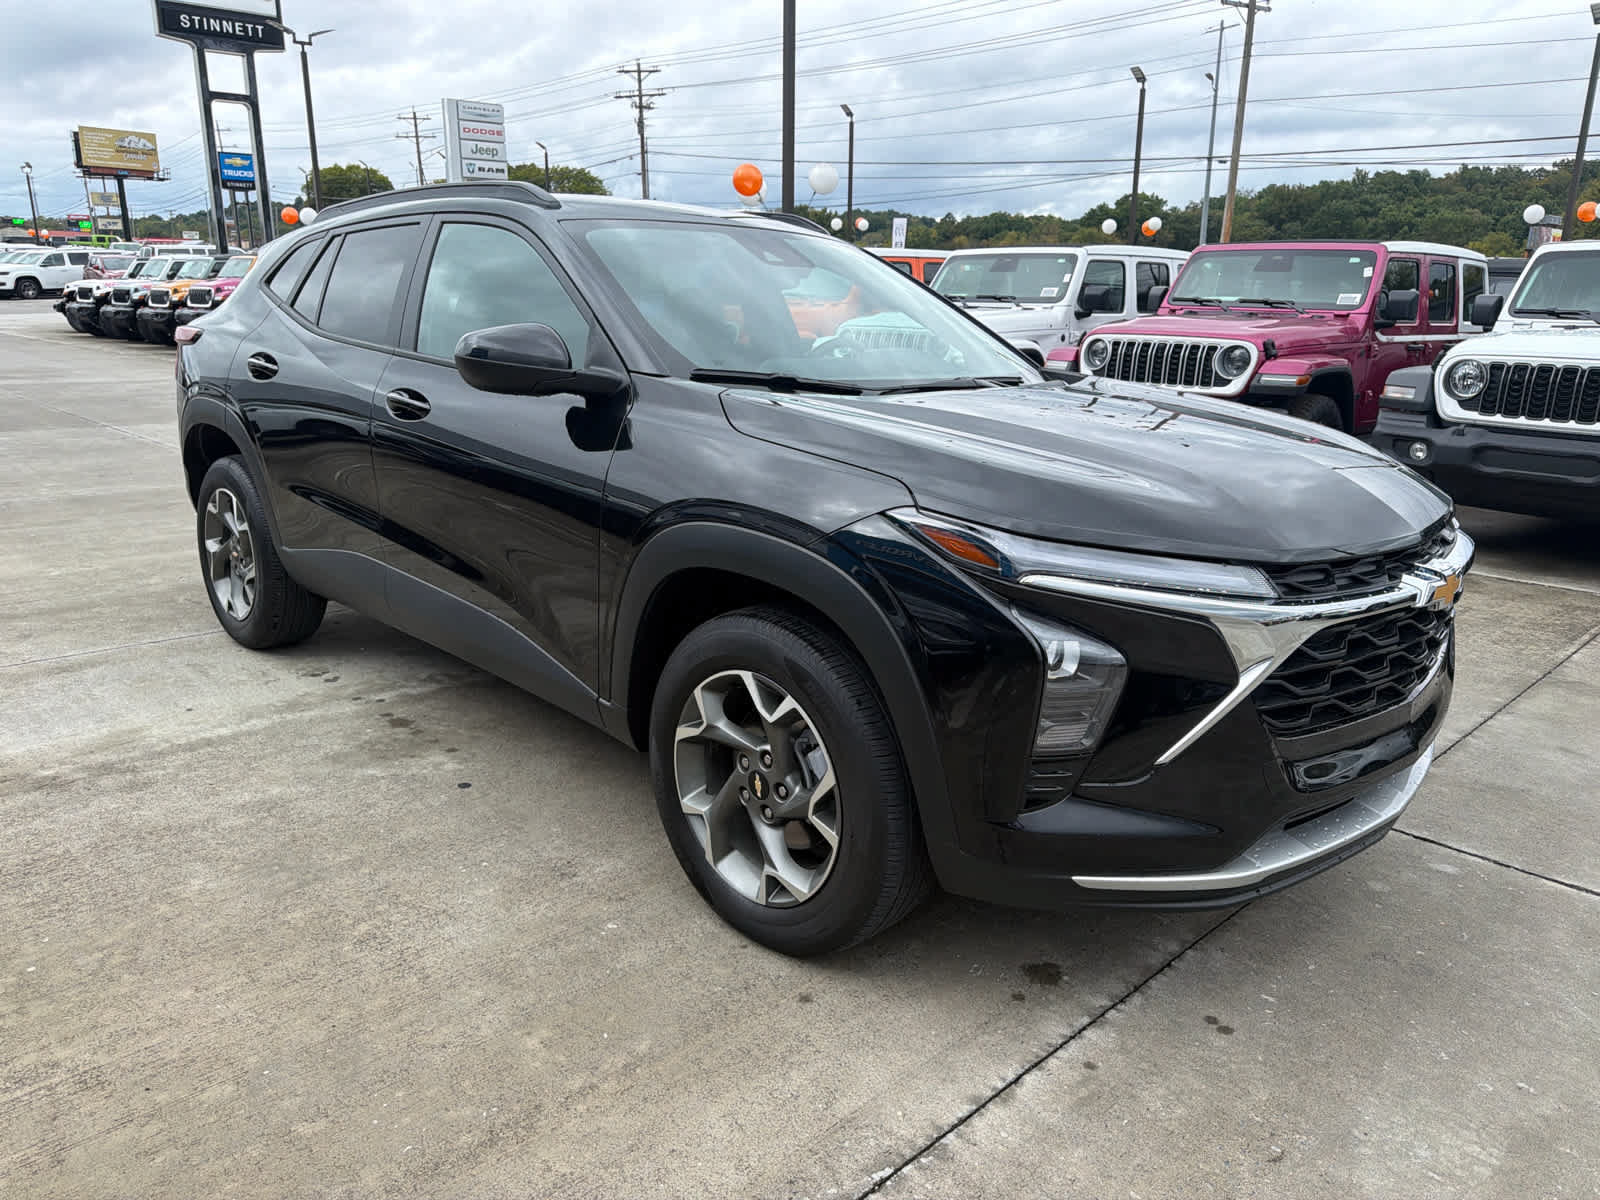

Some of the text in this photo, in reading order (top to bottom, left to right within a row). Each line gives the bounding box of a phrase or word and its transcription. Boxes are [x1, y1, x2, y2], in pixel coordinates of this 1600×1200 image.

[180, 14, 264, 38] STINNETT
[463, 127, 503, 136] DODGE
[471, 144, 498, 158] Jeep
[224, 169, 254, 177] TRUCKS
[478, 166, 505, 174] RAM
